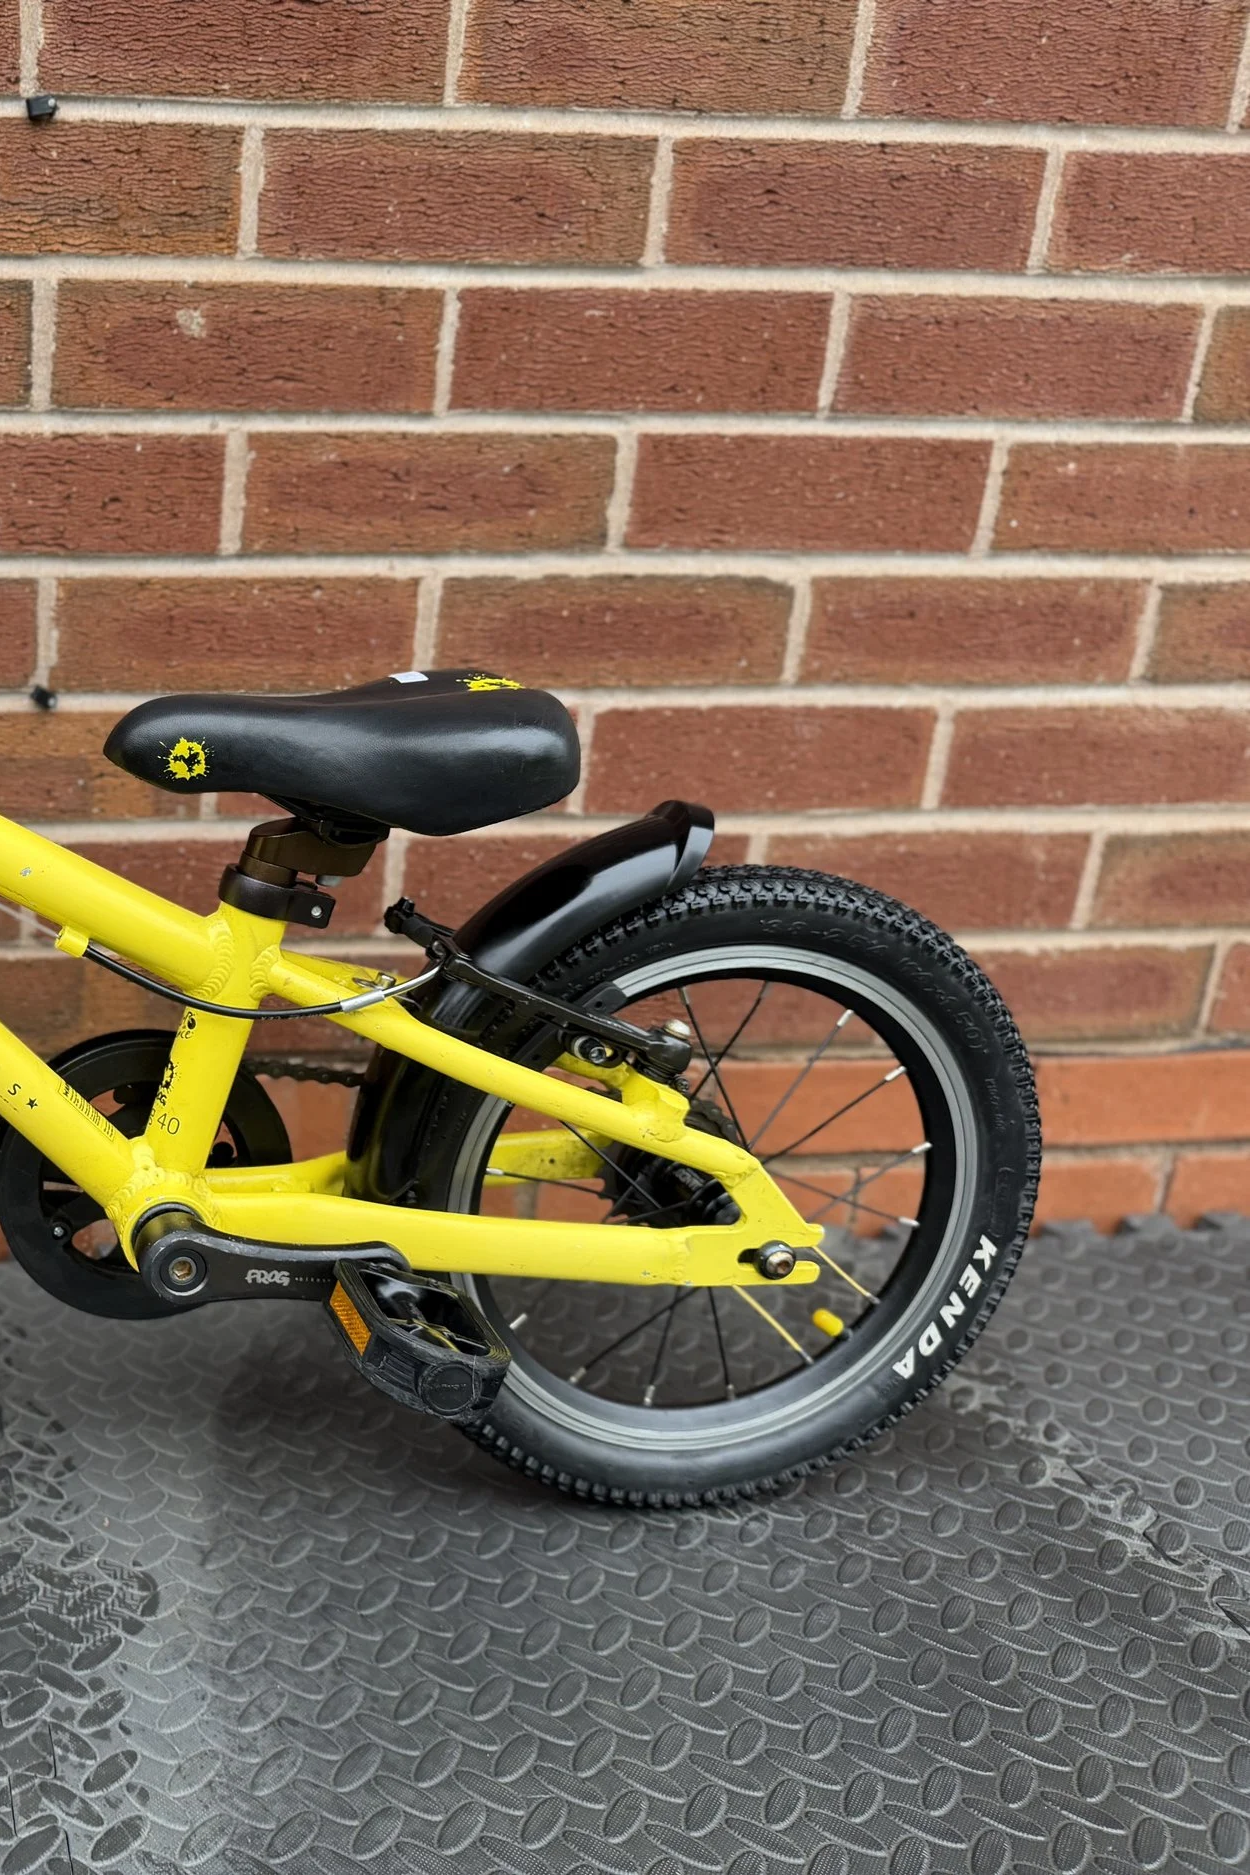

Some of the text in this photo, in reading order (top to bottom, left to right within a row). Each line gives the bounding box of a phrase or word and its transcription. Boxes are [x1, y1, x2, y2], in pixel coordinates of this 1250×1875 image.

[156, 1112, 181, 1136] 40
[245, 1269, 290, 1287] FROG
[892, 1234, 998, 1379] KENDA
